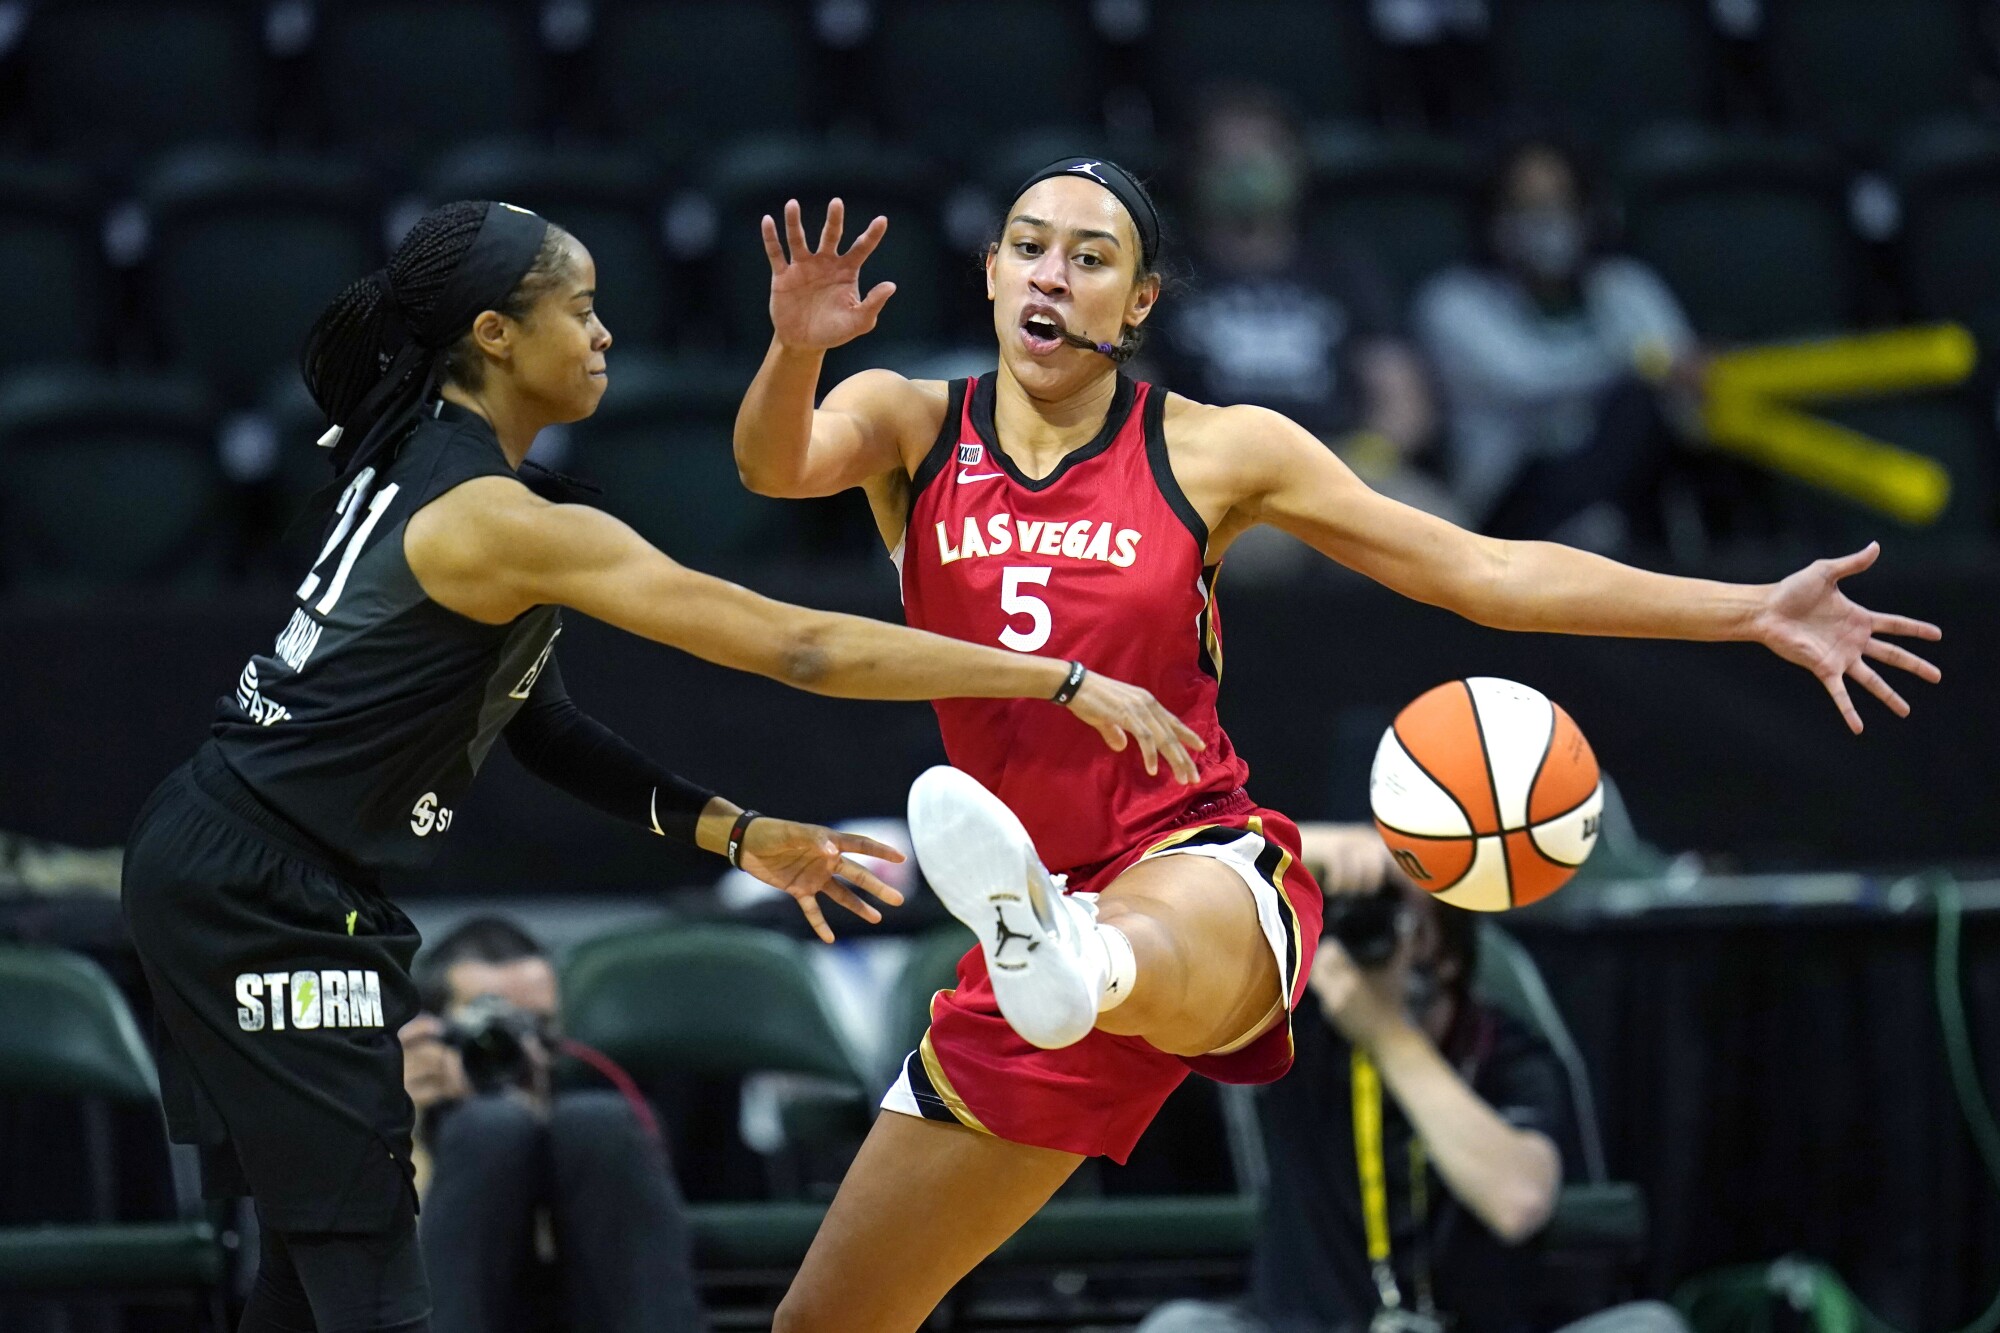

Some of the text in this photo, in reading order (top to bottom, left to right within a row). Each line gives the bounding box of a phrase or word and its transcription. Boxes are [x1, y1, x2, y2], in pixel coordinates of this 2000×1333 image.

[296, 466, 400, 616] 21
[935, 513, 1143, 568] LAS VEGAS
[997, 566, 1053, 652] 5
[235, 970, 385, 1032] STORM
